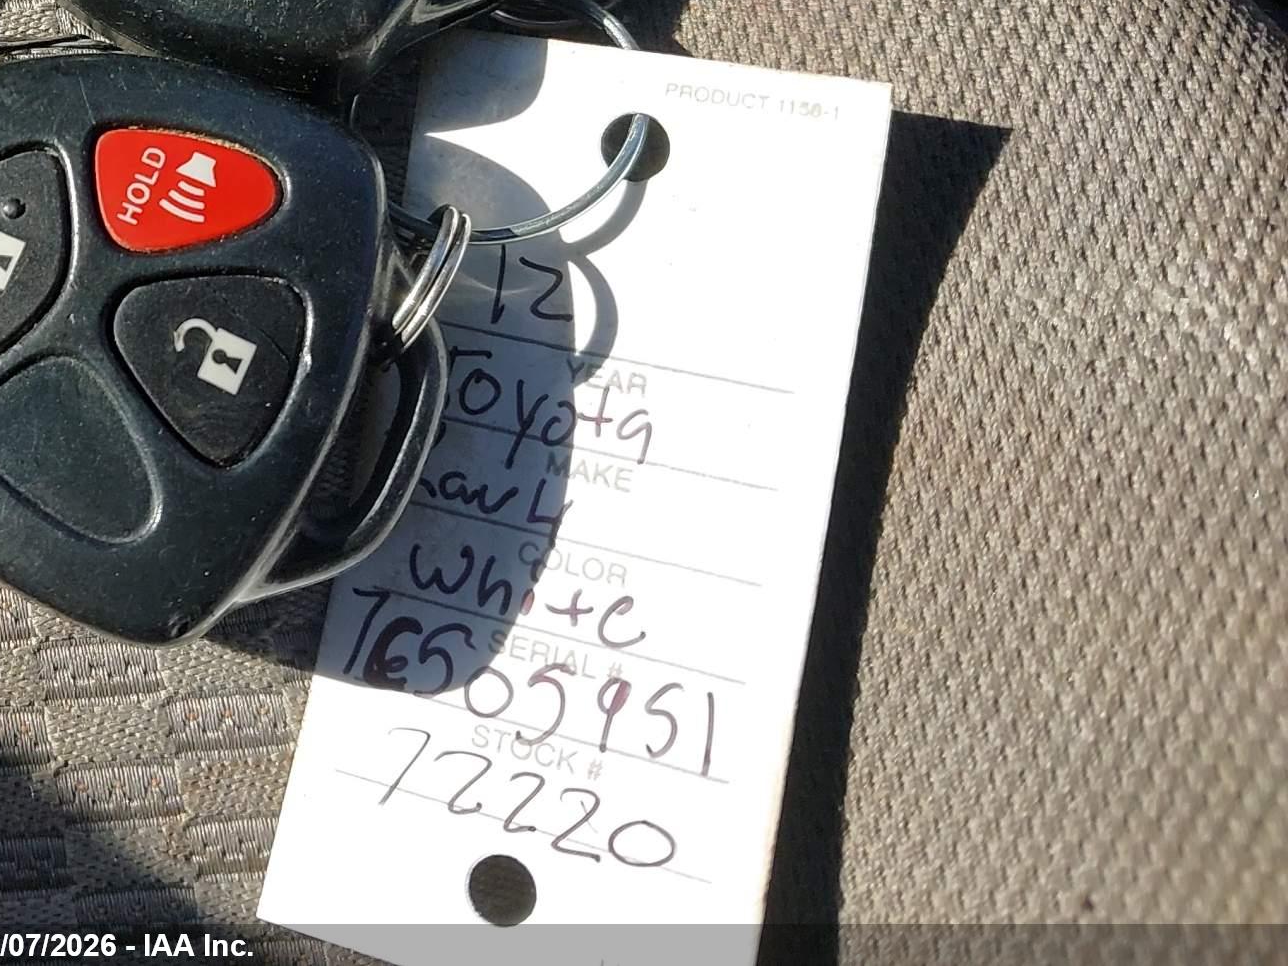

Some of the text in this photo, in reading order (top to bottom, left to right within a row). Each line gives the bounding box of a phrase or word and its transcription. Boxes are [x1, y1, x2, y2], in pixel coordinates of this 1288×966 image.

[664, 82, 771, 111] PRODUCT
[116, 146, 167, 226] HOLD
[491, 244, 573, 325] 12
[567, 357, 648, 398] YEAR
[545, 451, 634, 493] MAKE
[518, 540, 628, 586] COLOR
[487, 630, 598, 680] SERIAL
[471, 723, 577, 775] STOCK
[378, 726, 678, 868] 72220
